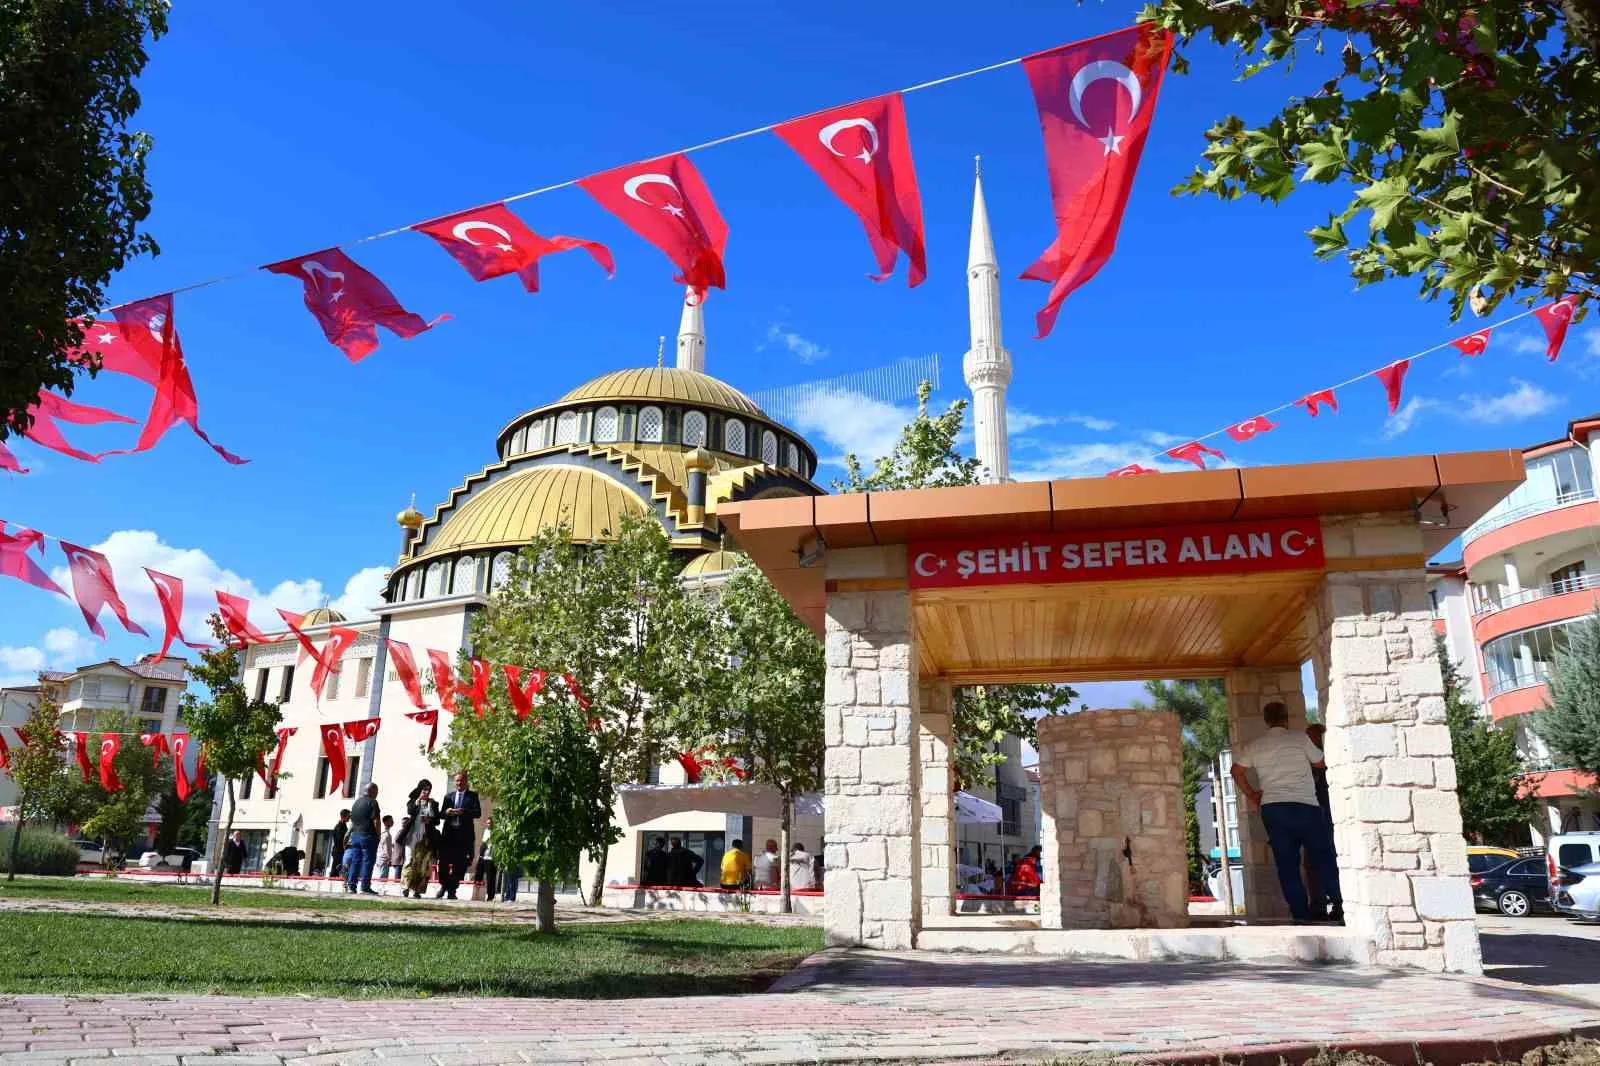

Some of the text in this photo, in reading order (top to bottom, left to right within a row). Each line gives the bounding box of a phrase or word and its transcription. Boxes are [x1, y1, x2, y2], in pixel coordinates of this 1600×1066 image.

[957, 533, 1273, 578] ŞEHİT SEFER ALAN
